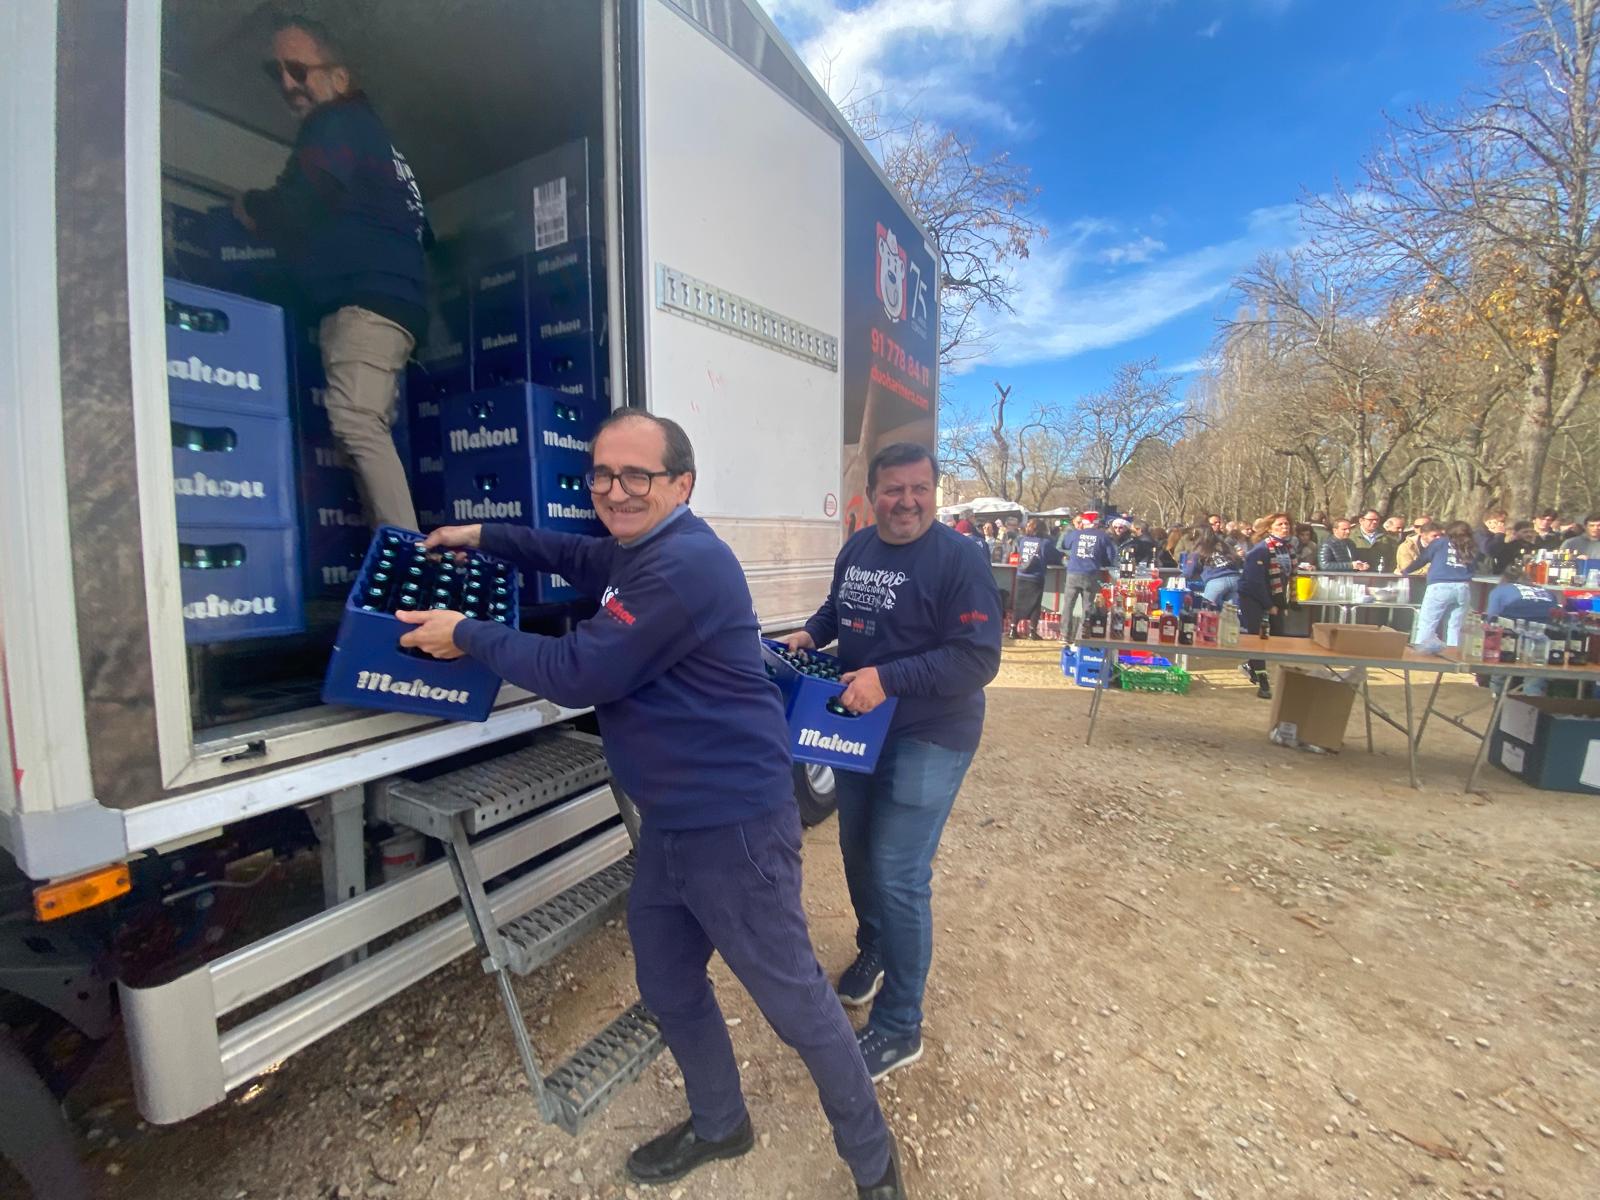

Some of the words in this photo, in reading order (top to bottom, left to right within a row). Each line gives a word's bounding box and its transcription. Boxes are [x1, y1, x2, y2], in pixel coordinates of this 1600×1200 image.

[910, 260, 928, 320] 75
[871, 327, 884, 357] 91
[887, 337, 905, 371] 778
[168, 356, 262, 391] ahou
[450, 425, 519, 452] Mahou
[174, 472, 266, 499] ahou
[453, 497, 522, 520] Mahou
[844, 565, 910, 588] Vermutero
[183, 594, 277, 620] ahou
[357, 671, 470, 705] Mahou
[798, 728, 867, 757] Mahou
